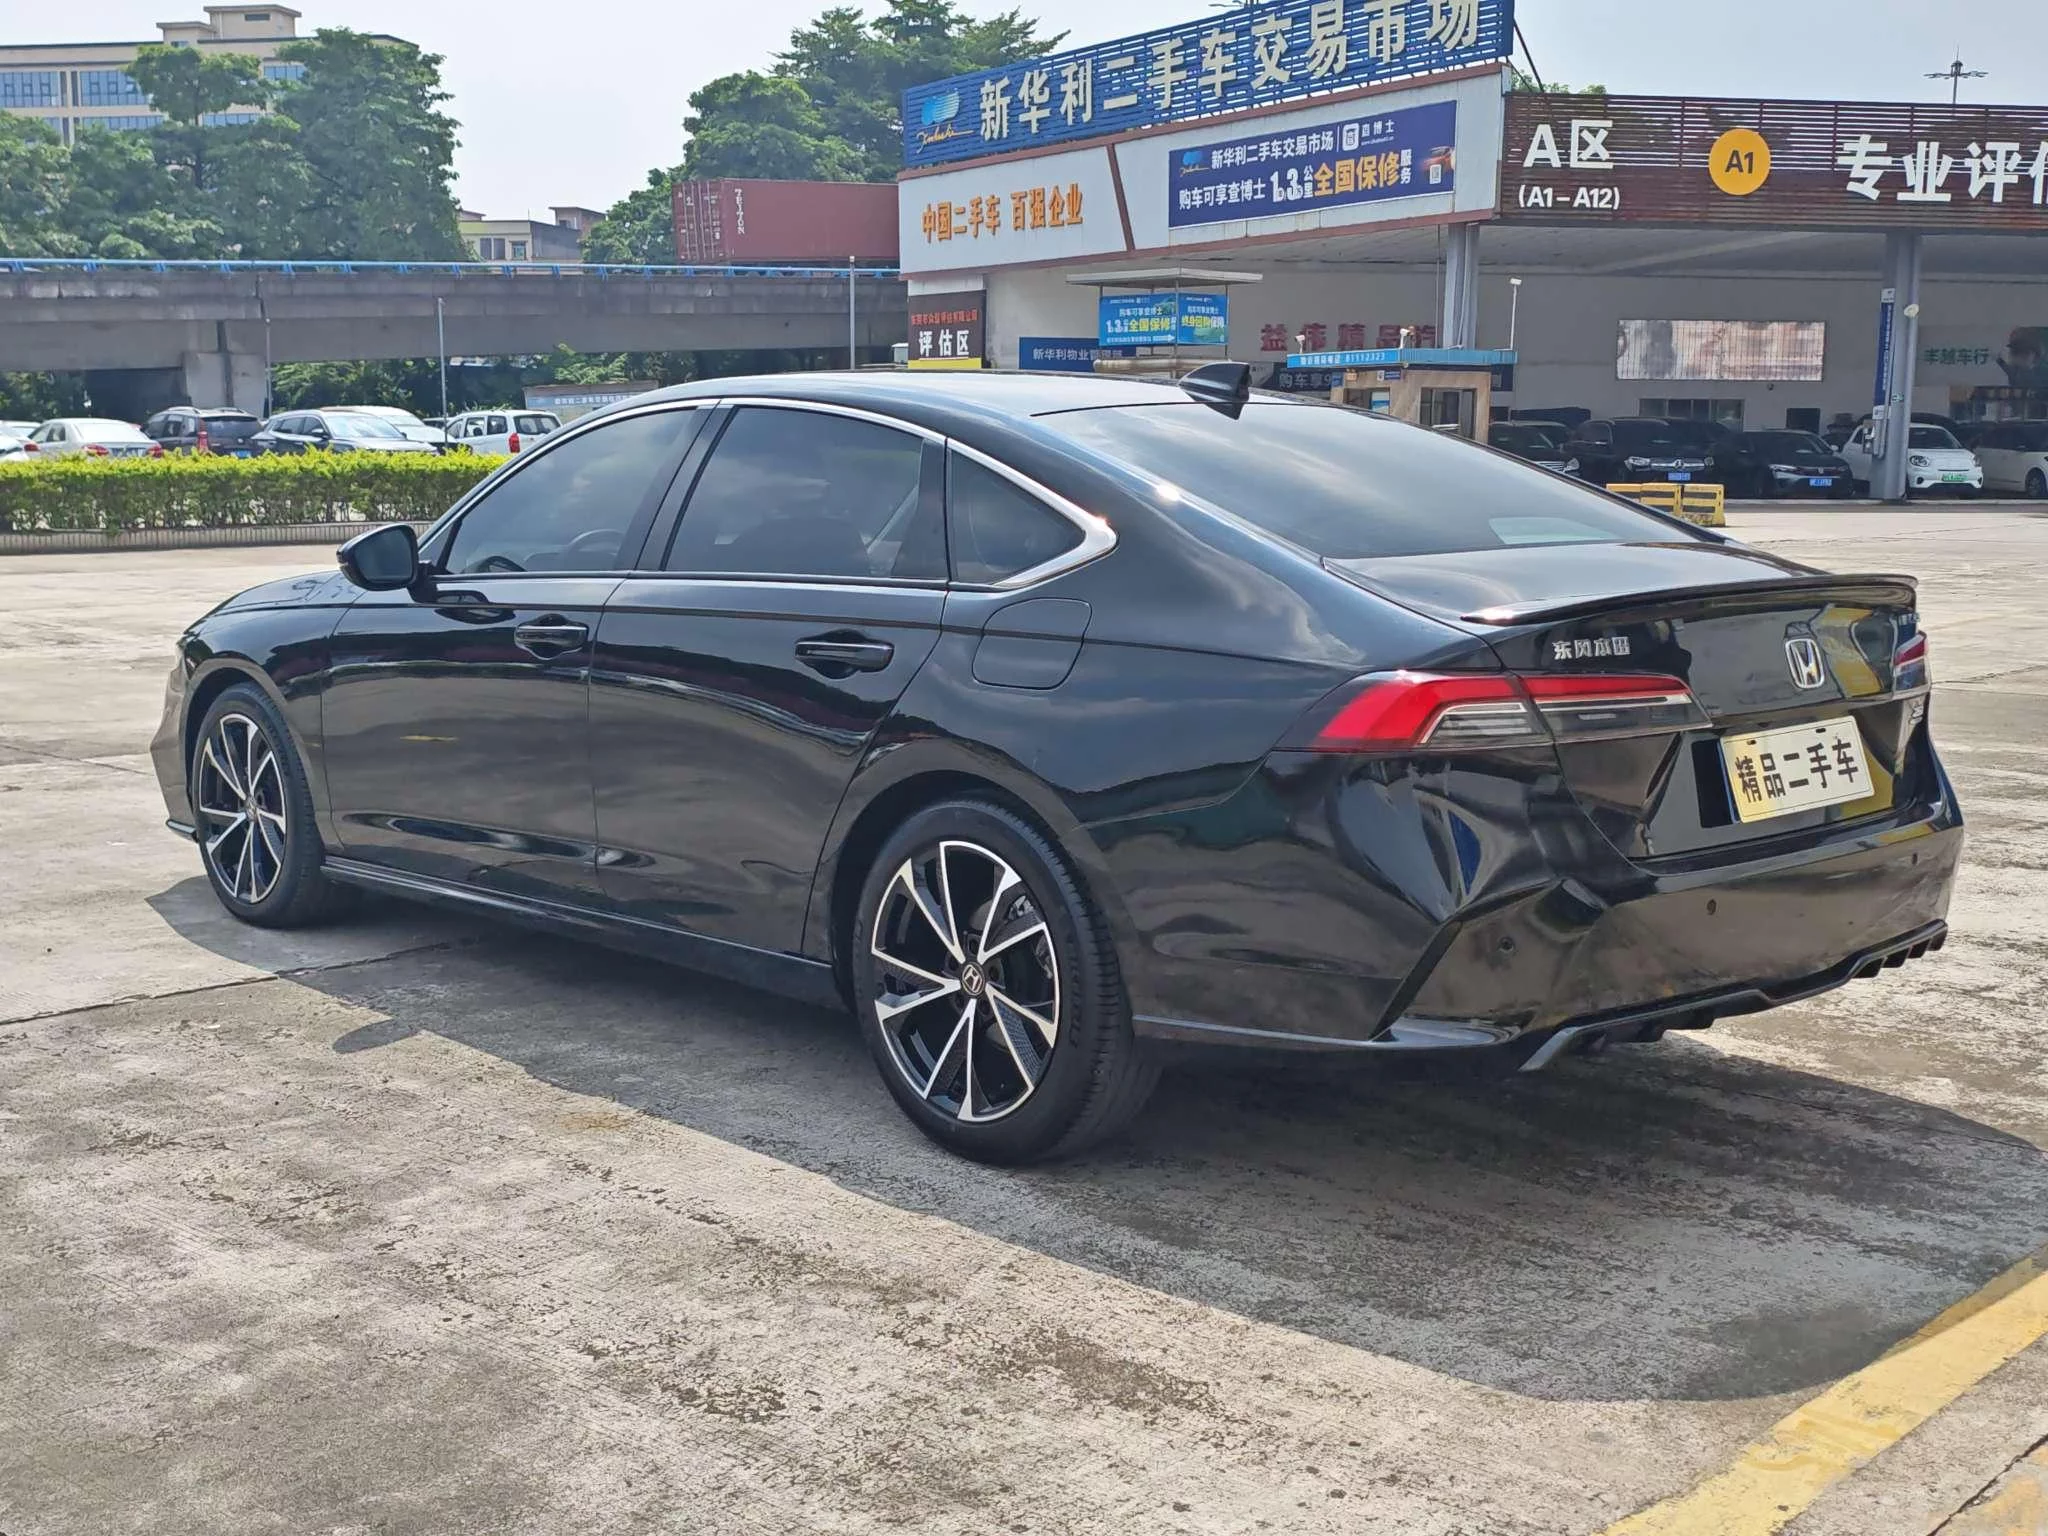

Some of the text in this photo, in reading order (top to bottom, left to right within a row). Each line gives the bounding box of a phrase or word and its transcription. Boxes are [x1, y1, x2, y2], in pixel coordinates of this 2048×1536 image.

[979, 0, 1479, 142] 新华利二手车交易市场
[1211, 131, 1334, 169] 新华利二手车交易市场
[1522, 119, 1614, 169] A区
[1724, 150, 1756, 175] A1
[1313, 151, 1400, 197] 全国保修
[922, 183, 1083, 244] 中国二手车 百强企业
[919, 328, 970, 357] 评估区
[1553, 636, 1631, 660] 东风本田
[1737, 739, 1859, 803] 精品二手车
